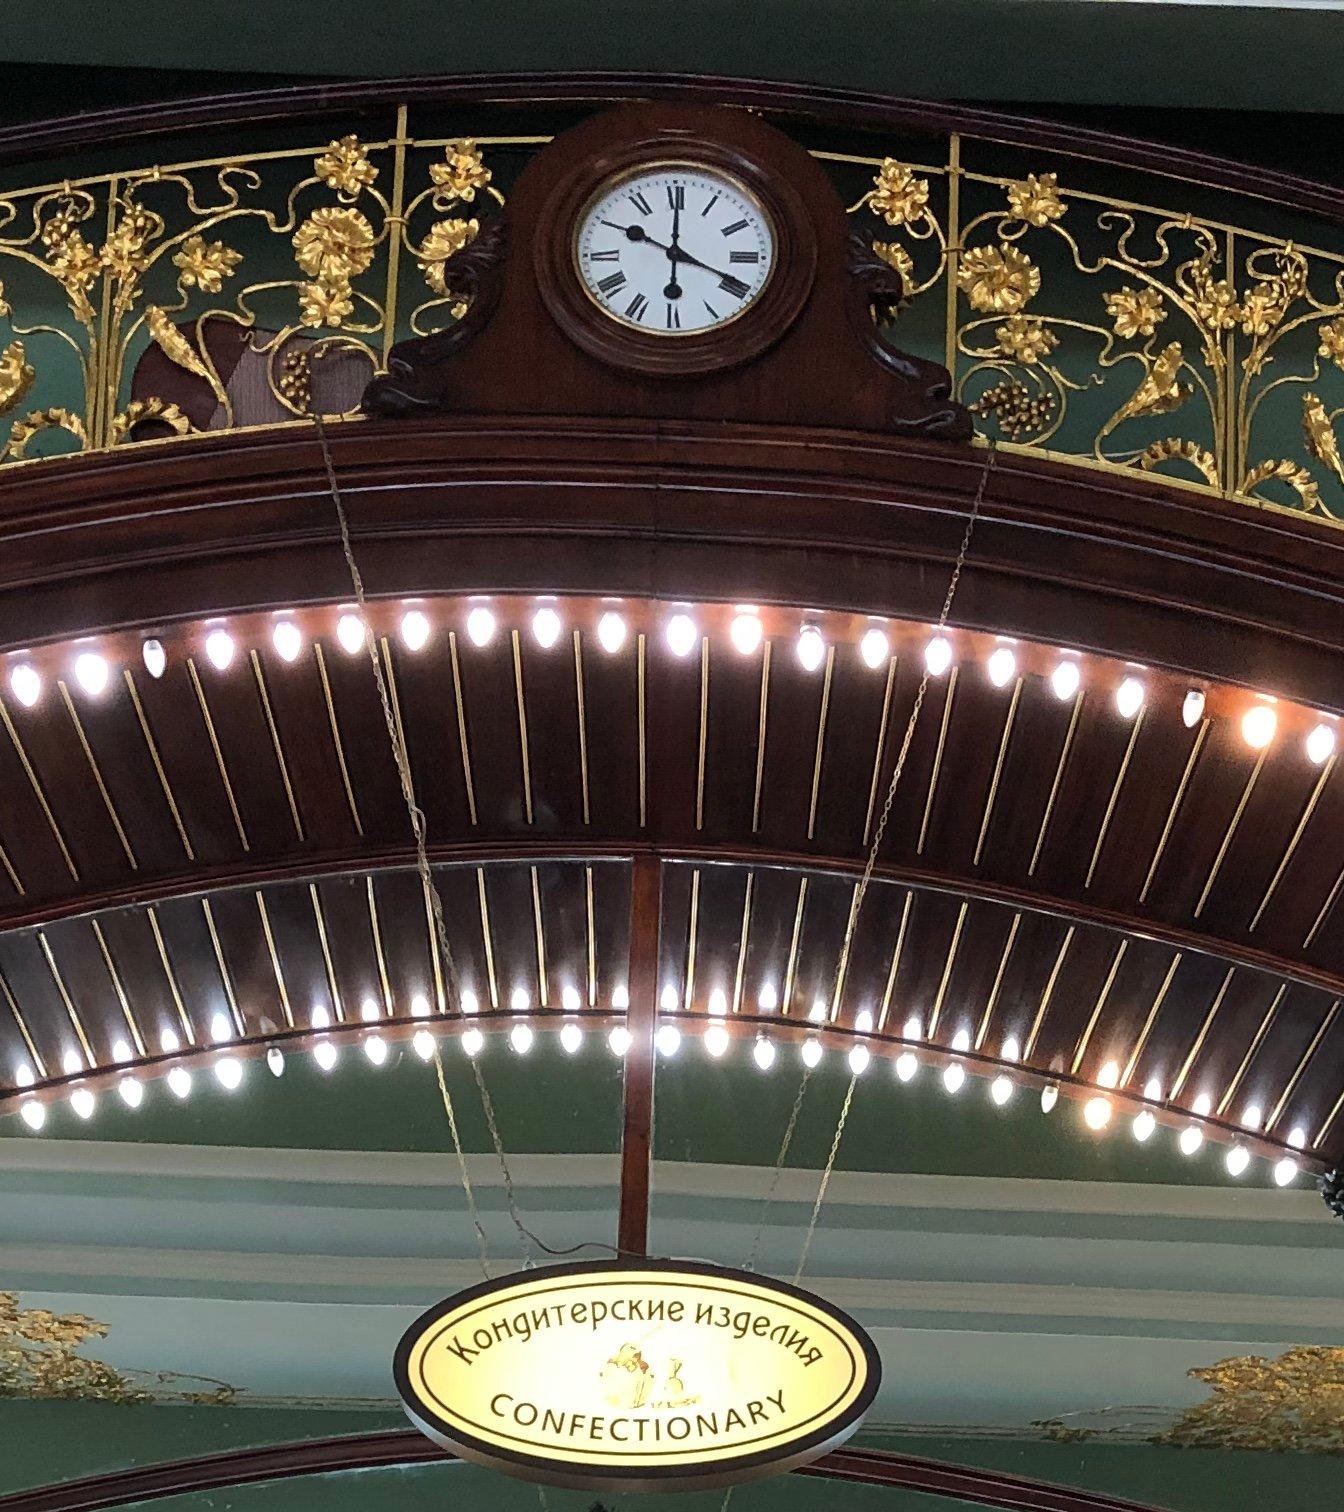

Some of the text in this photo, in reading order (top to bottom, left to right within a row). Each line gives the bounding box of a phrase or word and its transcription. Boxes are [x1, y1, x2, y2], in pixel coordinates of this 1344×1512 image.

[445, 1296, 824, 1369] Кондитерские изделия
[490, 1389, 787, 1442] CONFECTIONARY
